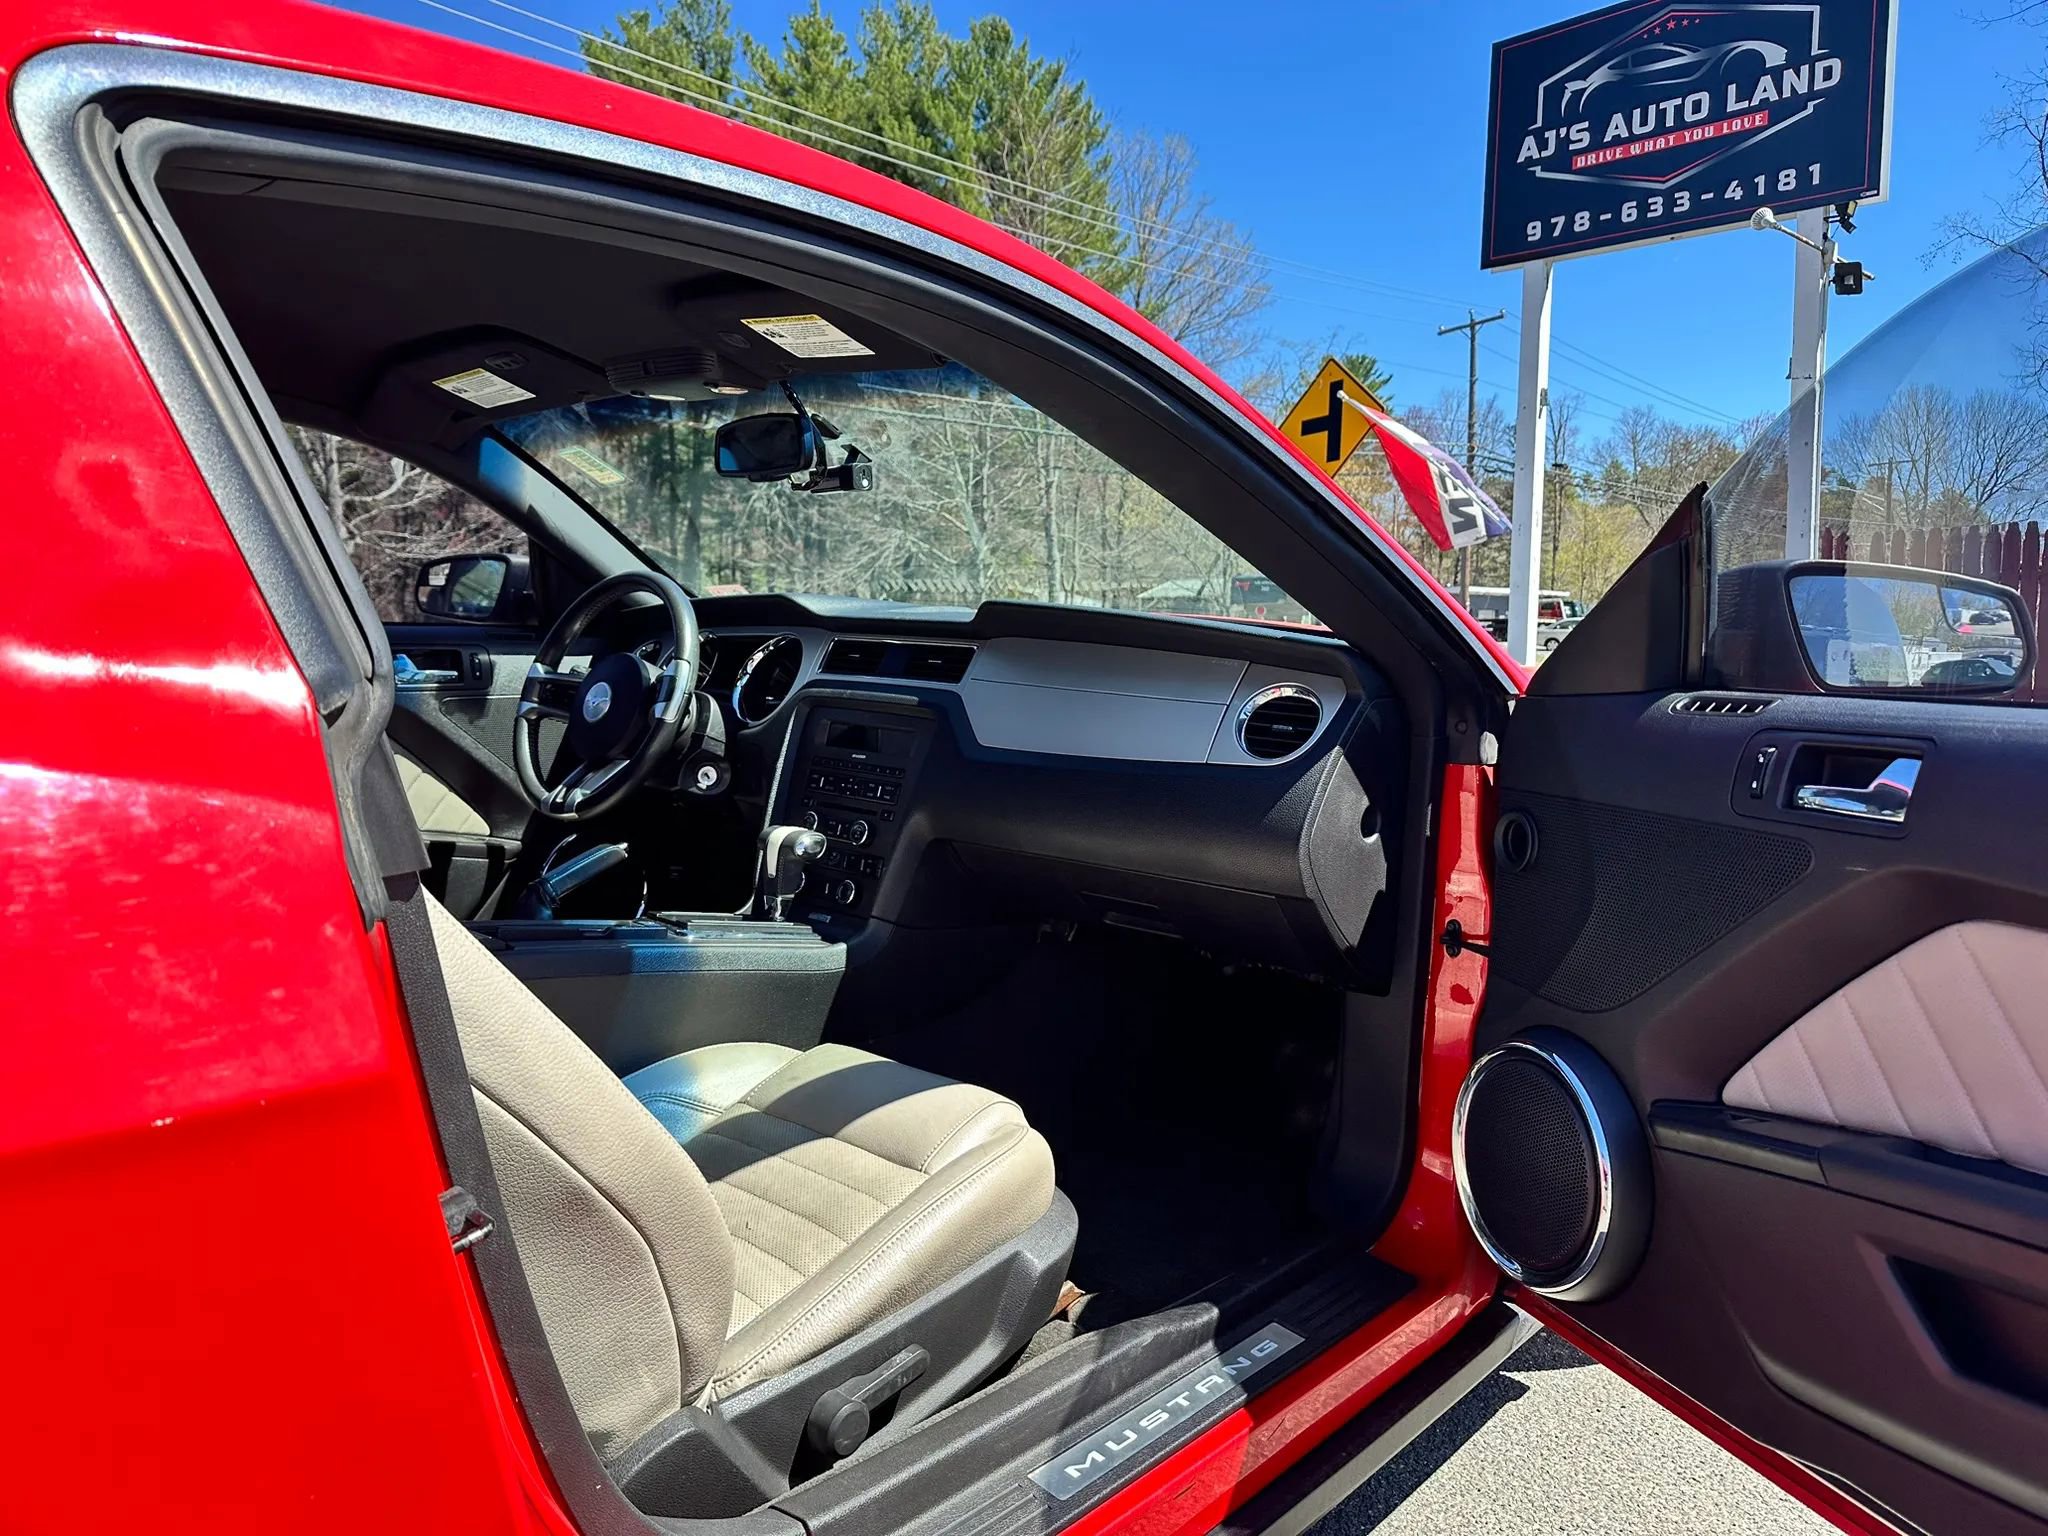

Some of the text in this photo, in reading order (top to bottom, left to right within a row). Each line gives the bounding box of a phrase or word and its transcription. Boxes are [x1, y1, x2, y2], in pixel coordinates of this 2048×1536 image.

[1517, 57, 1842, 163] AJ'S AUTO LAND
[1576, 113, 1764, 167] DRIVE WHAT YOU LOVE
[1526, 163, 1821, 242] 978-633-4181
[1063, 1339, 1279, 1479] MUSTANG
